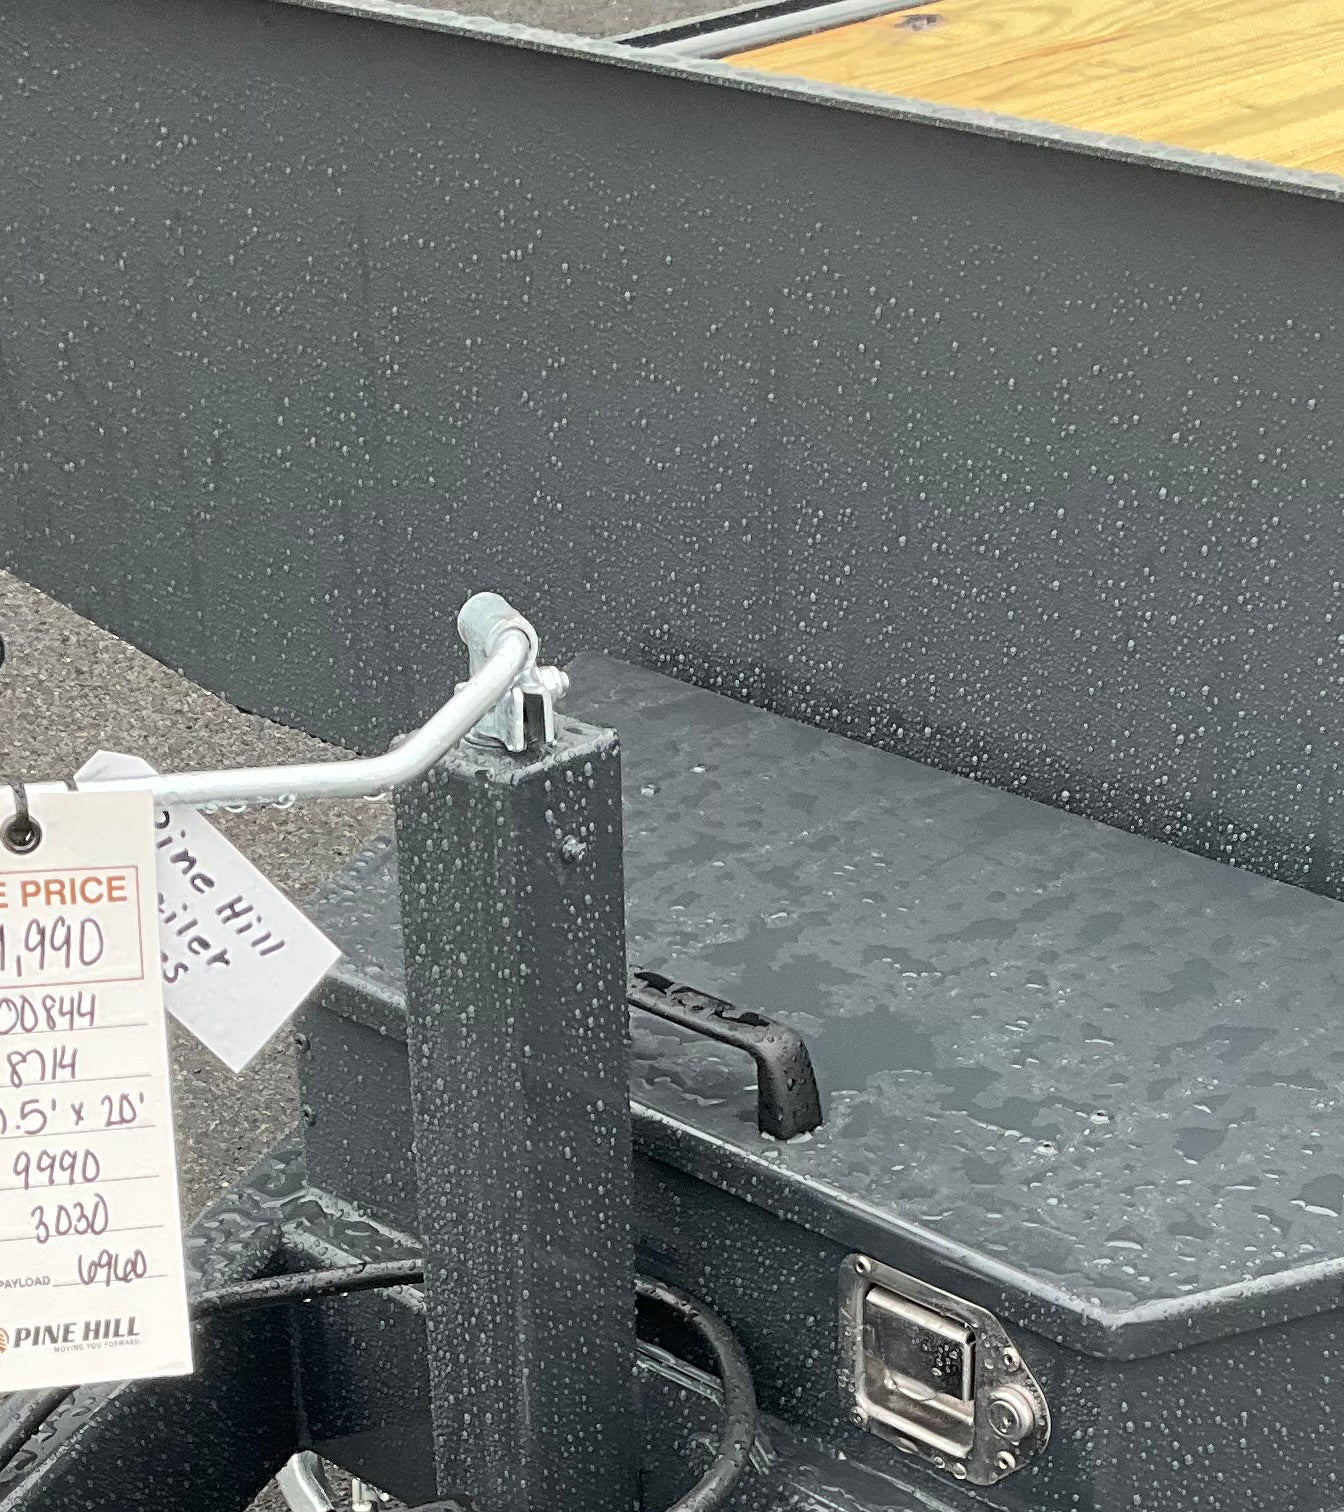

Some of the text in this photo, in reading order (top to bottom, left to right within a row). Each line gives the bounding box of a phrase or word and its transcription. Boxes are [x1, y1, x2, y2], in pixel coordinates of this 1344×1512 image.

[20, 875, 128, 908] PRICE
[215, 895, 286, 956] Hill
[6, 1045, 78, 1089] 8714
[12, 1148, 101, 1191] 9990
[30, 1192, 109, 1245] 3030
[13, 1316, 141, 1348] PINE HILL
